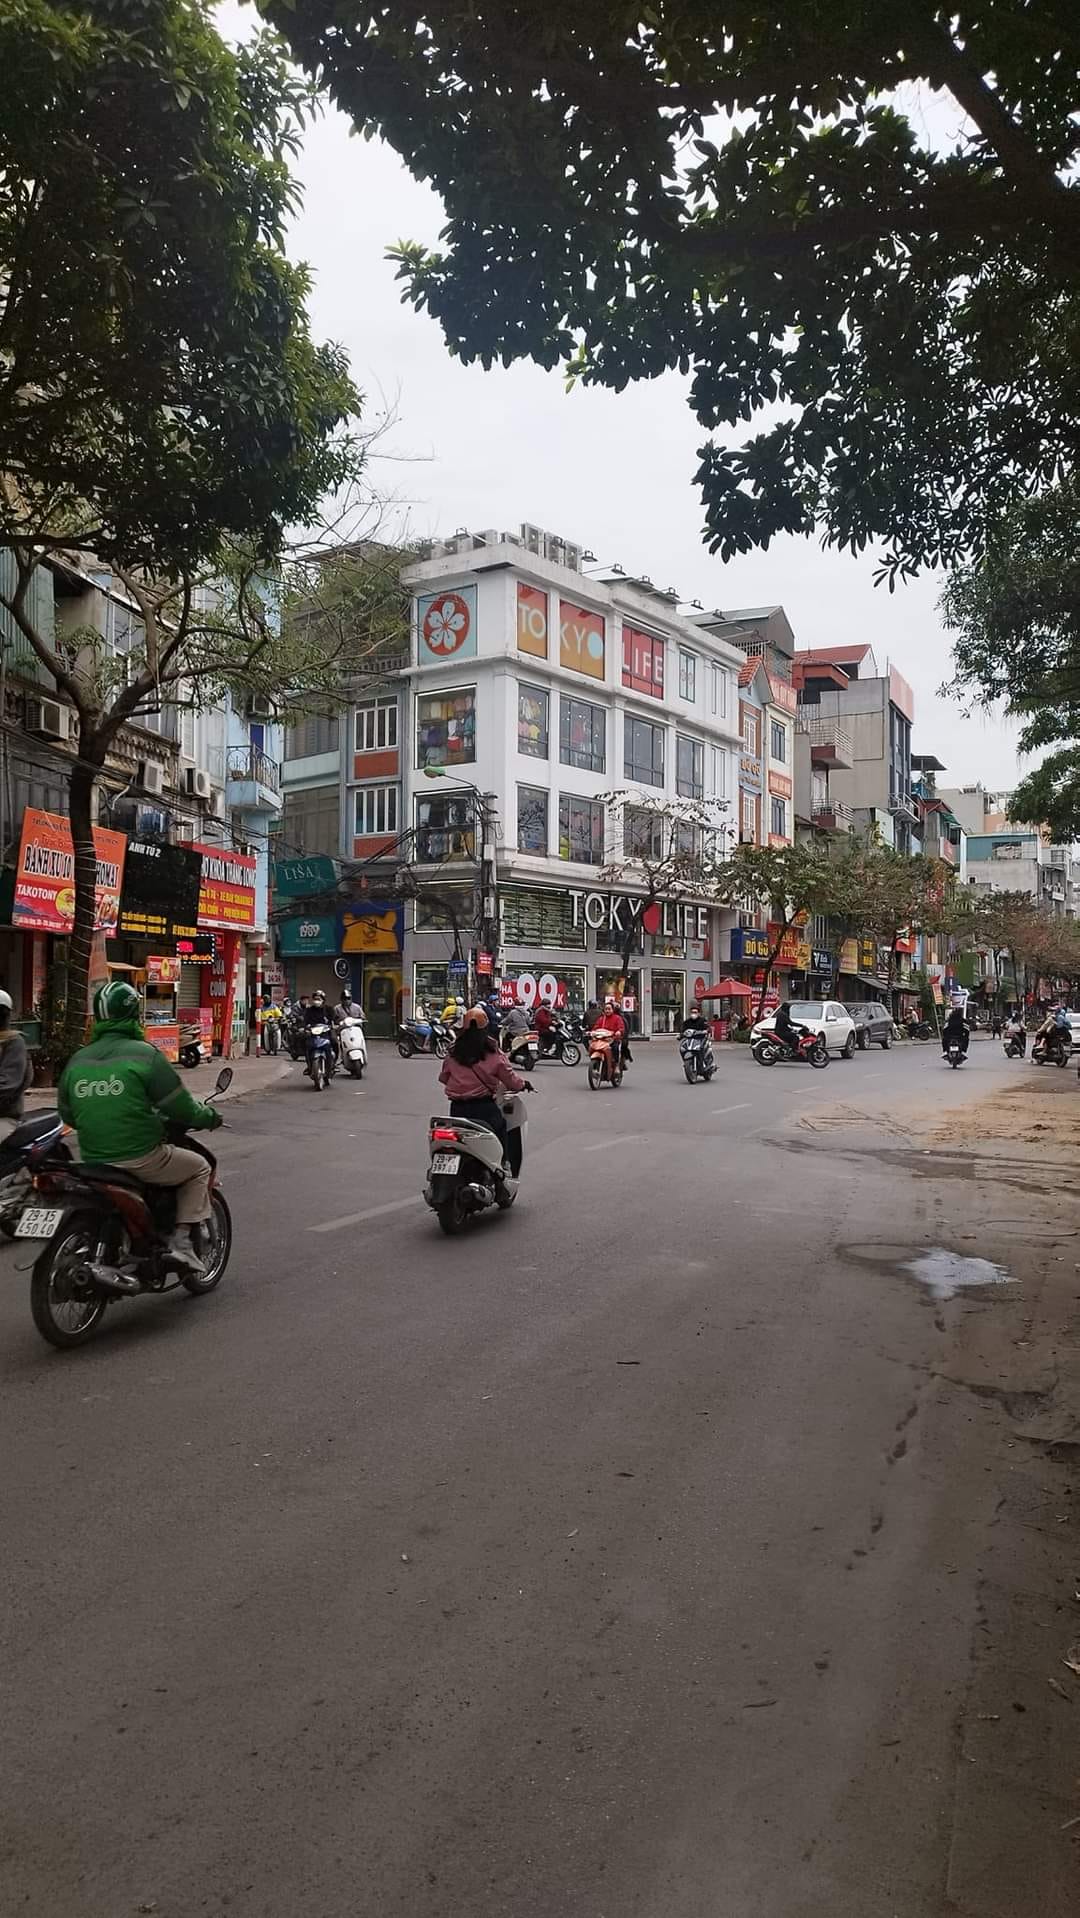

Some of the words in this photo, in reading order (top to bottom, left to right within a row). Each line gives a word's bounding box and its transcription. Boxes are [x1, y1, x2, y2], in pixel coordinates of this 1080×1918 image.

[622, 641, 663, 682] LIFE
[663, 901, 708, 940] LIFE
[74, 1074, 125, 1099] Grab
